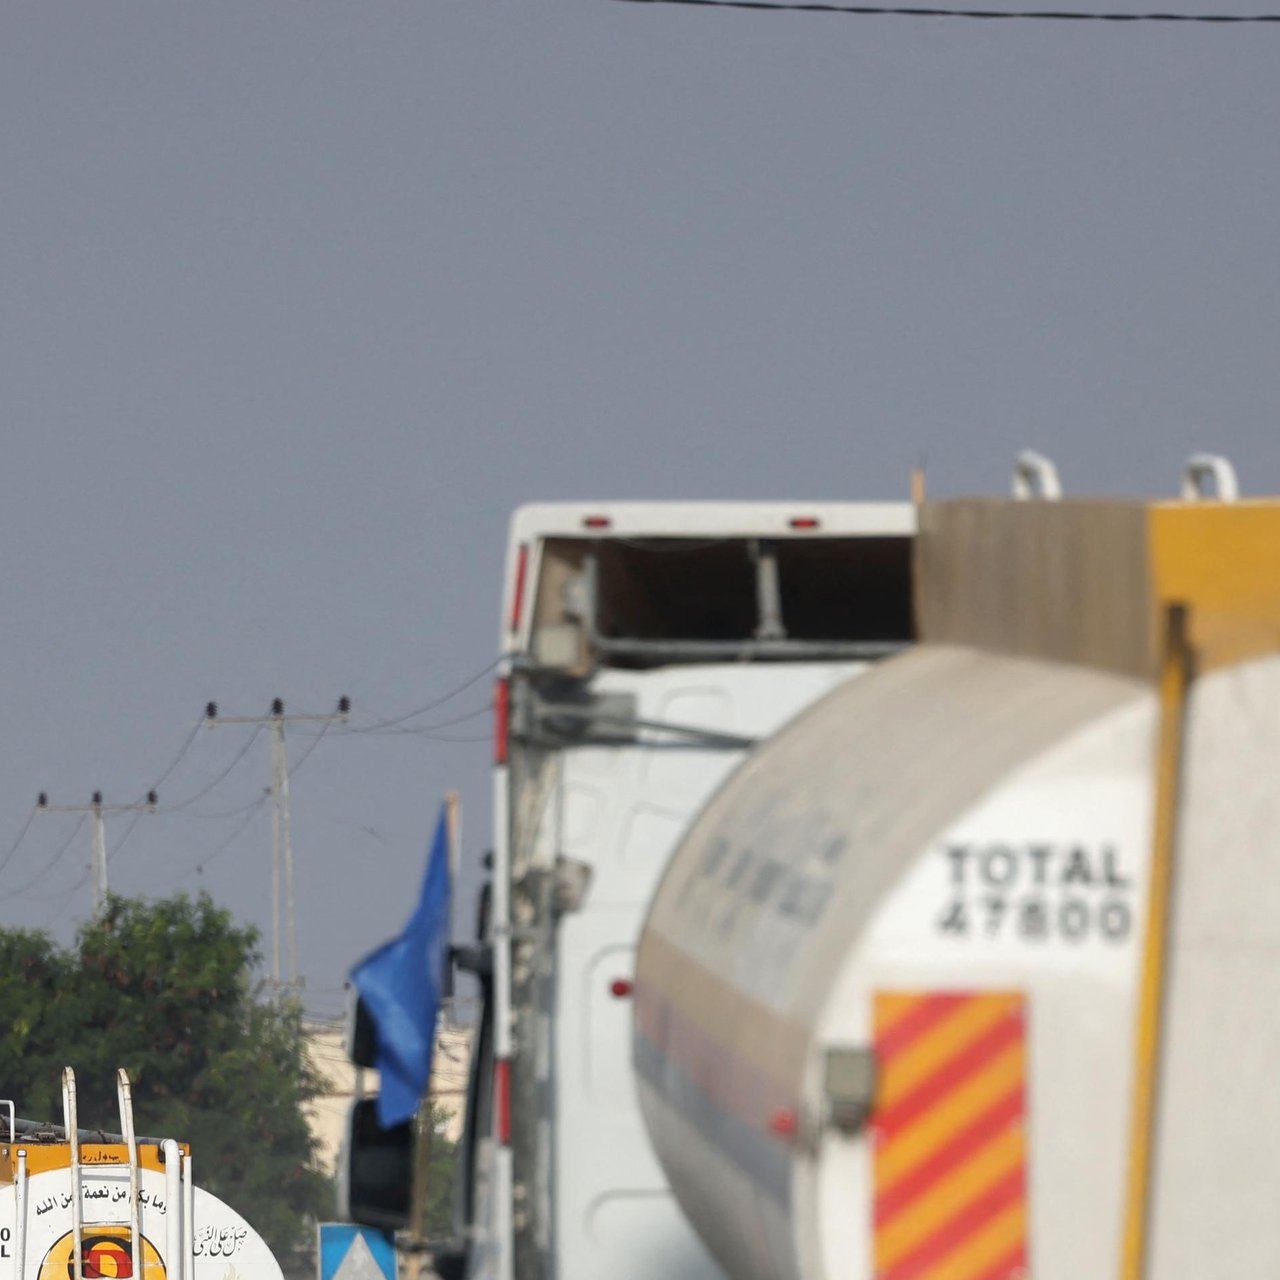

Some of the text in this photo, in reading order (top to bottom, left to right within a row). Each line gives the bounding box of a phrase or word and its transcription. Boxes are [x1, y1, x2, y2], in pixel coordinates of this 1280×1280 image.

[944, 846, 1133, 887] TOTAL
[82, 1185, 109, 1199] نعمة
[112, 1187, 127, 1202] من
[36, 1196, 58, 1216] الله
